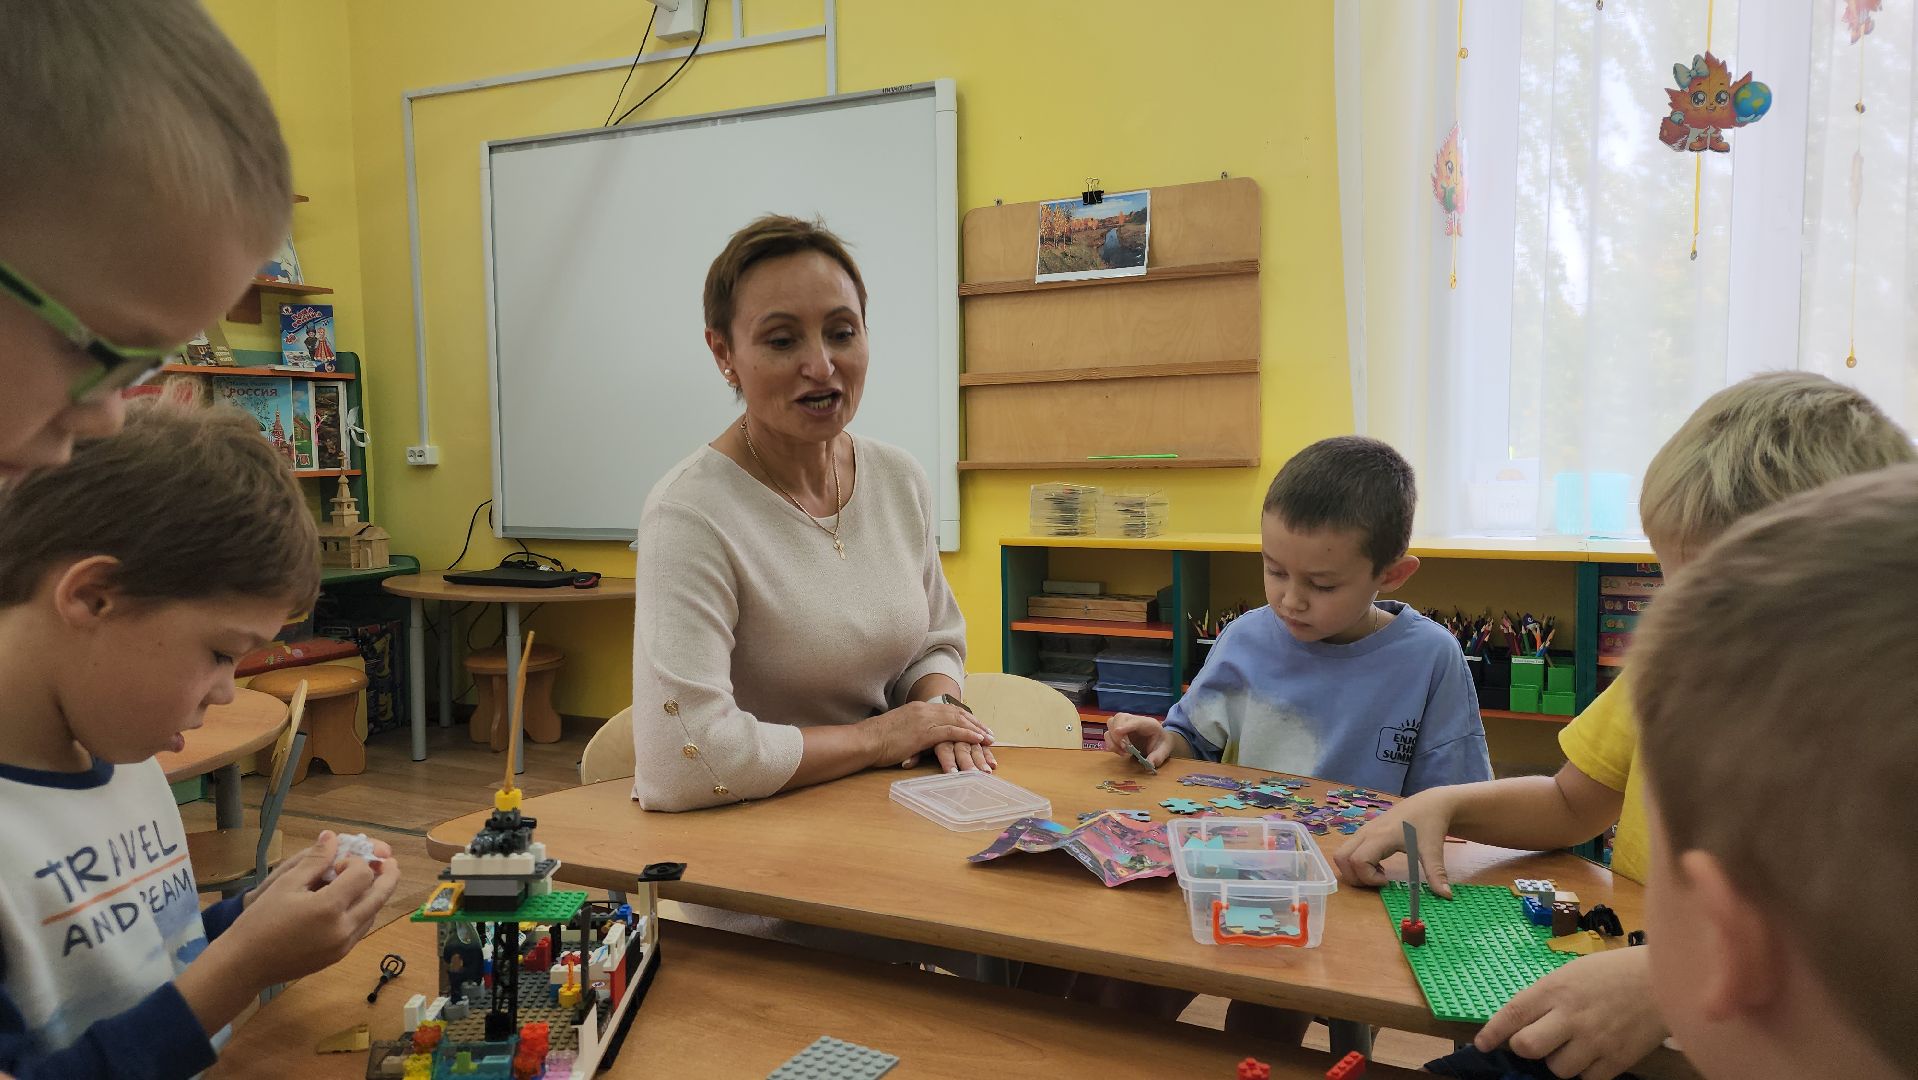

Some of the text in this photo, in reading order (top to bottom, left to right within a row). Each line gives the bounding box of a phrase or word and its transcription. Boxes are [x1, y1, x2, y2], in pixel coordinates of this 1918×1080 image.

[228, 387, 278, 398] РОССИЯ
[1382, 749, 1412, 763] SUMM
[35, 820, 178, 903] TRAVEL
[62, 902, 139, 957] AND
